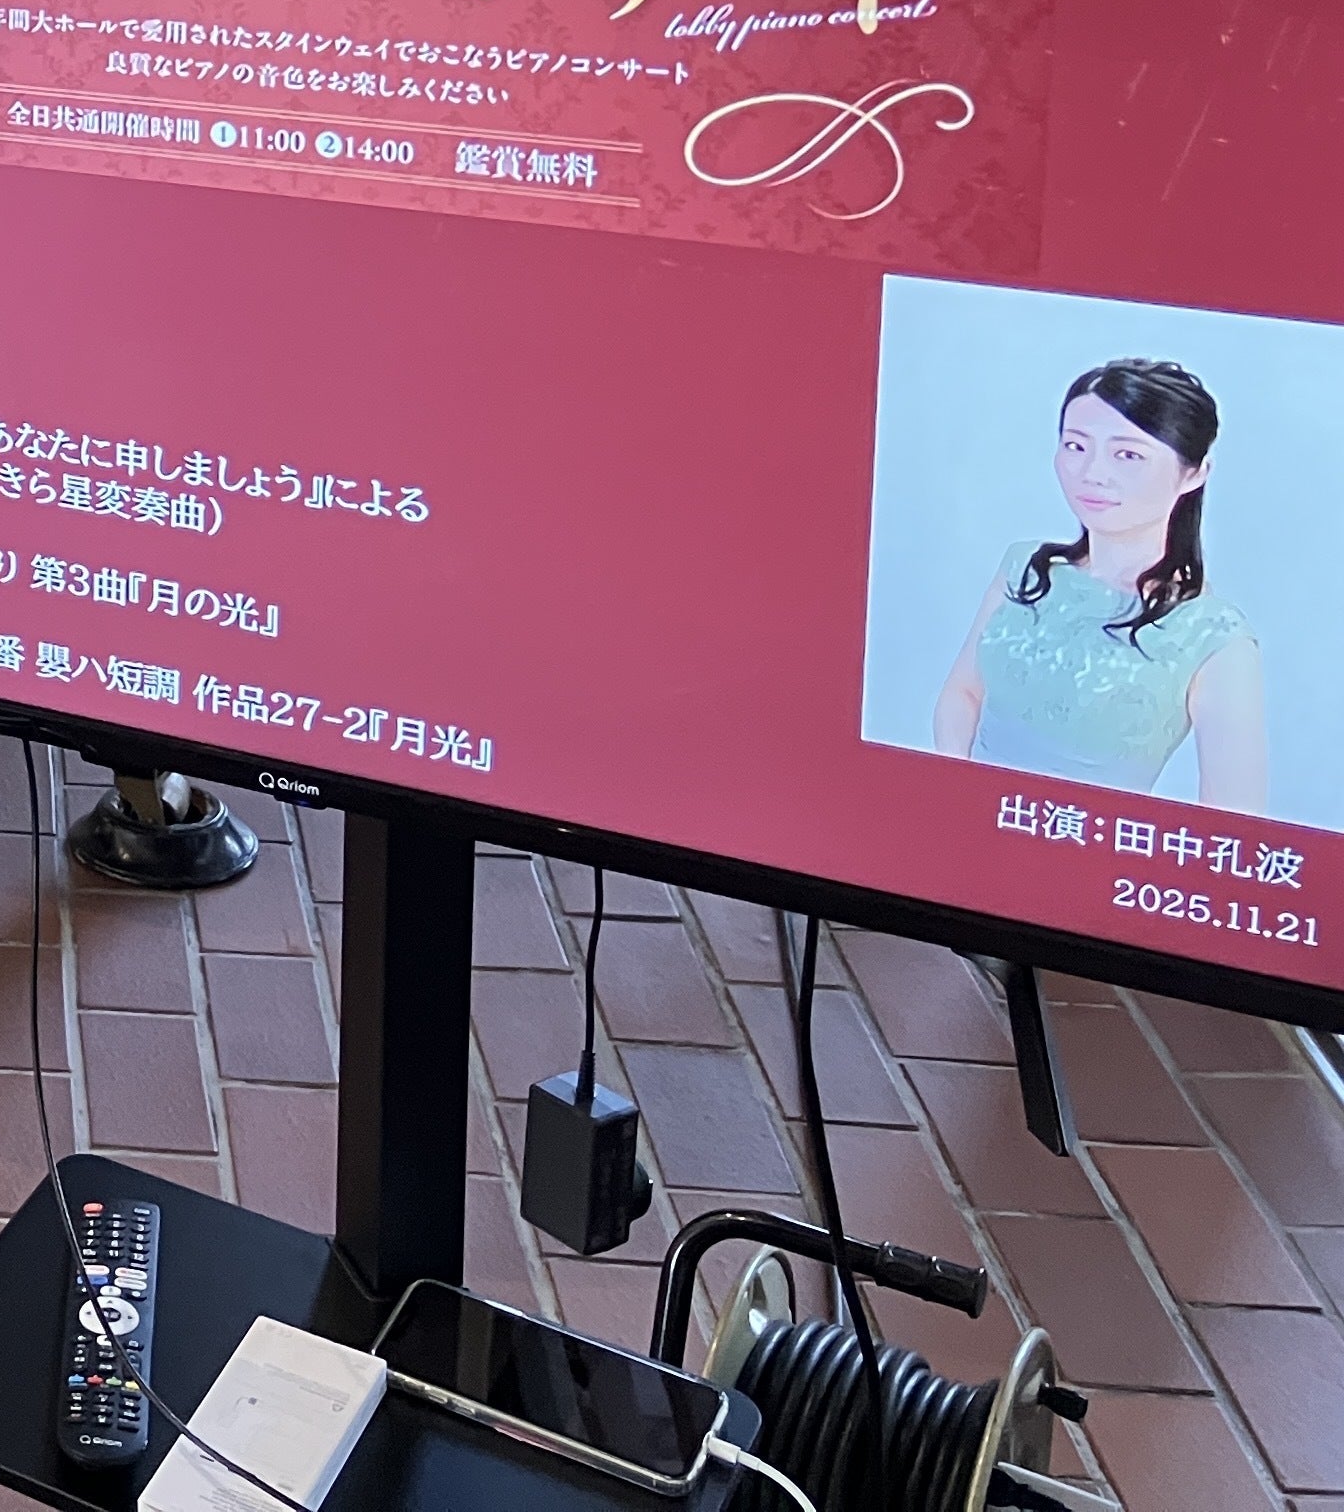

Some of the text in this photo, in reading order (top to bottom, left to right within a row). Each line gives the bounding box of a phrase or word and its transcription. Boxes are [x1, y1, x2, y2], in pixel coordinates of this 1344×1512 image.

[664, 3, 737, 52] lobby
[731, 10, 823, 51] piano
[106, 50, 509, 105] 良質なピアノの音色をお楽しみください
[7, 102, 201, 145] 全日共通開催時間
[454, 140, 597, 188] 鑑賞無料
[30, 553, 279, 638] 第3曲『月の光』
[277, 777, 320, 796] Qriom
[1112, 879, 1319, 947] 2025.11.21
